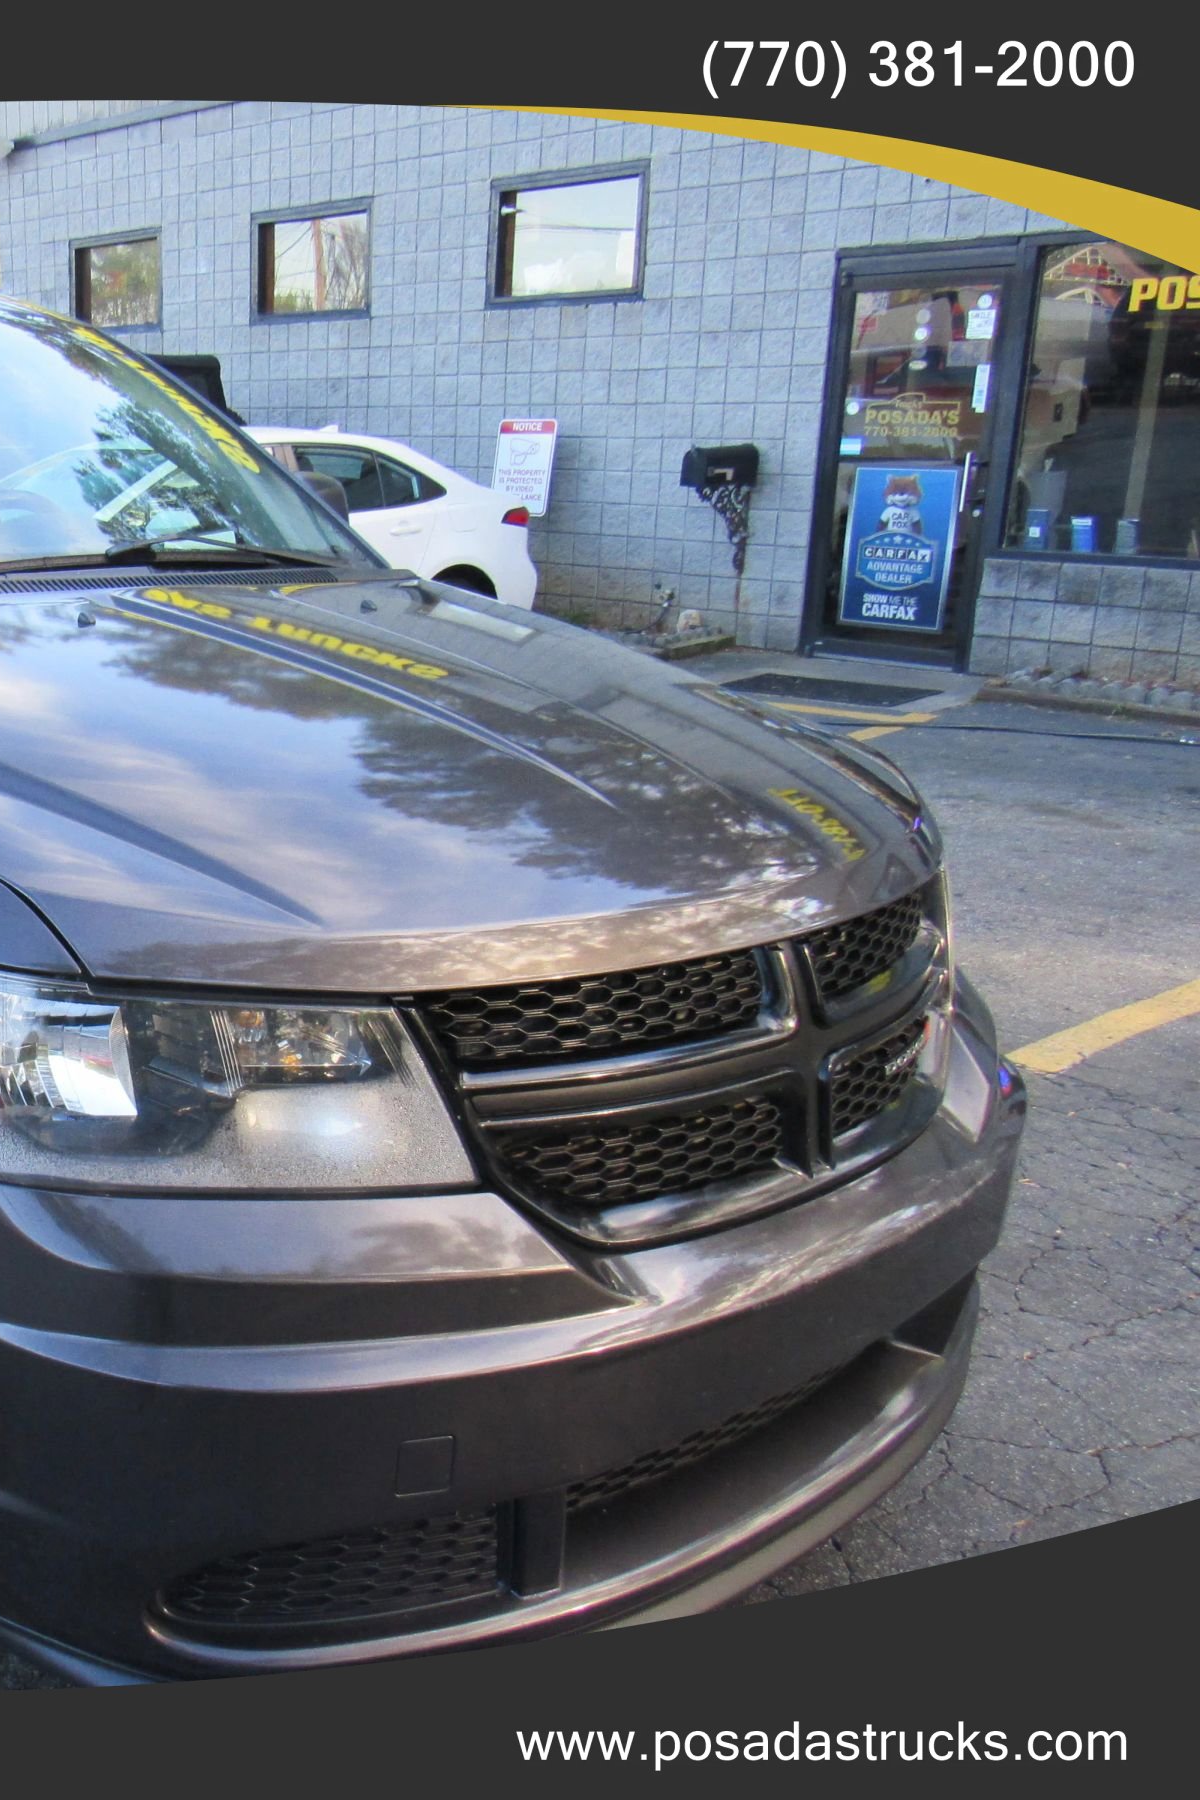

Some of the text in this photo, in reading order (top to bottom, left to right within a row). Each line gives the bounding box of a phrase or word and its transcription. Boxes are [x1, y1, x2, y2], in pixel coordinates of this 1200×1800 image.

[865, 409, 959, 425] POSADA'S
[512, 422, 542, 432] NOTICE
[512, 469, 545, 477] PROPERTY
[506, 477, 543, 485] PROTECTED
[515, 485, 534, 493] VIDEO
[891, 512, 910, 521] CAR
[892, 520, 909, 529] FOX
[864, 547, 930, 562] CARFAX
[867, 561, 923, 574] ADVANTAGE
[875, 572, 913, 584] DEALER
[863, 593, 919, 607] SHOW ME THE
[862, 602, 918, 621] CARFAX
